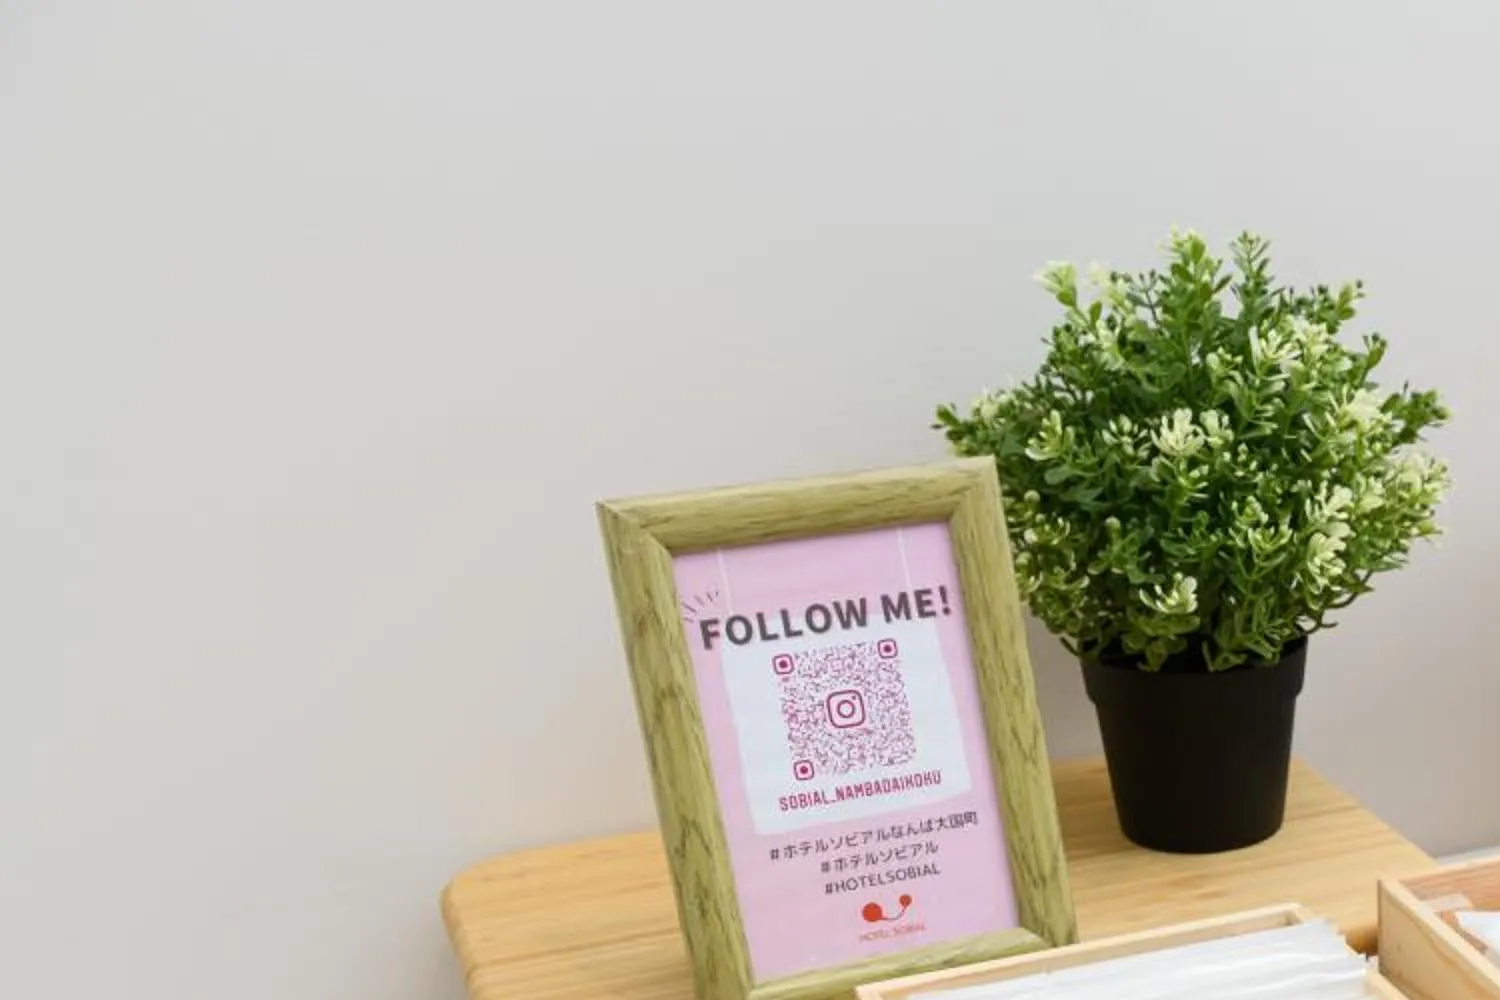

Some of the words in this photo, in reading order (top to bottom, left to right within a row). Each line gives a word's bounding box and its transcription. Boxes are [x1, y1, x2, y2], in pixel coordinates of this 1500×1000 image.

[700, 597, 868, 651] FOLLOW
[880, 585, 951, 624] ME!
[825, 862, 941, 895] #HOTELSOBIAL
